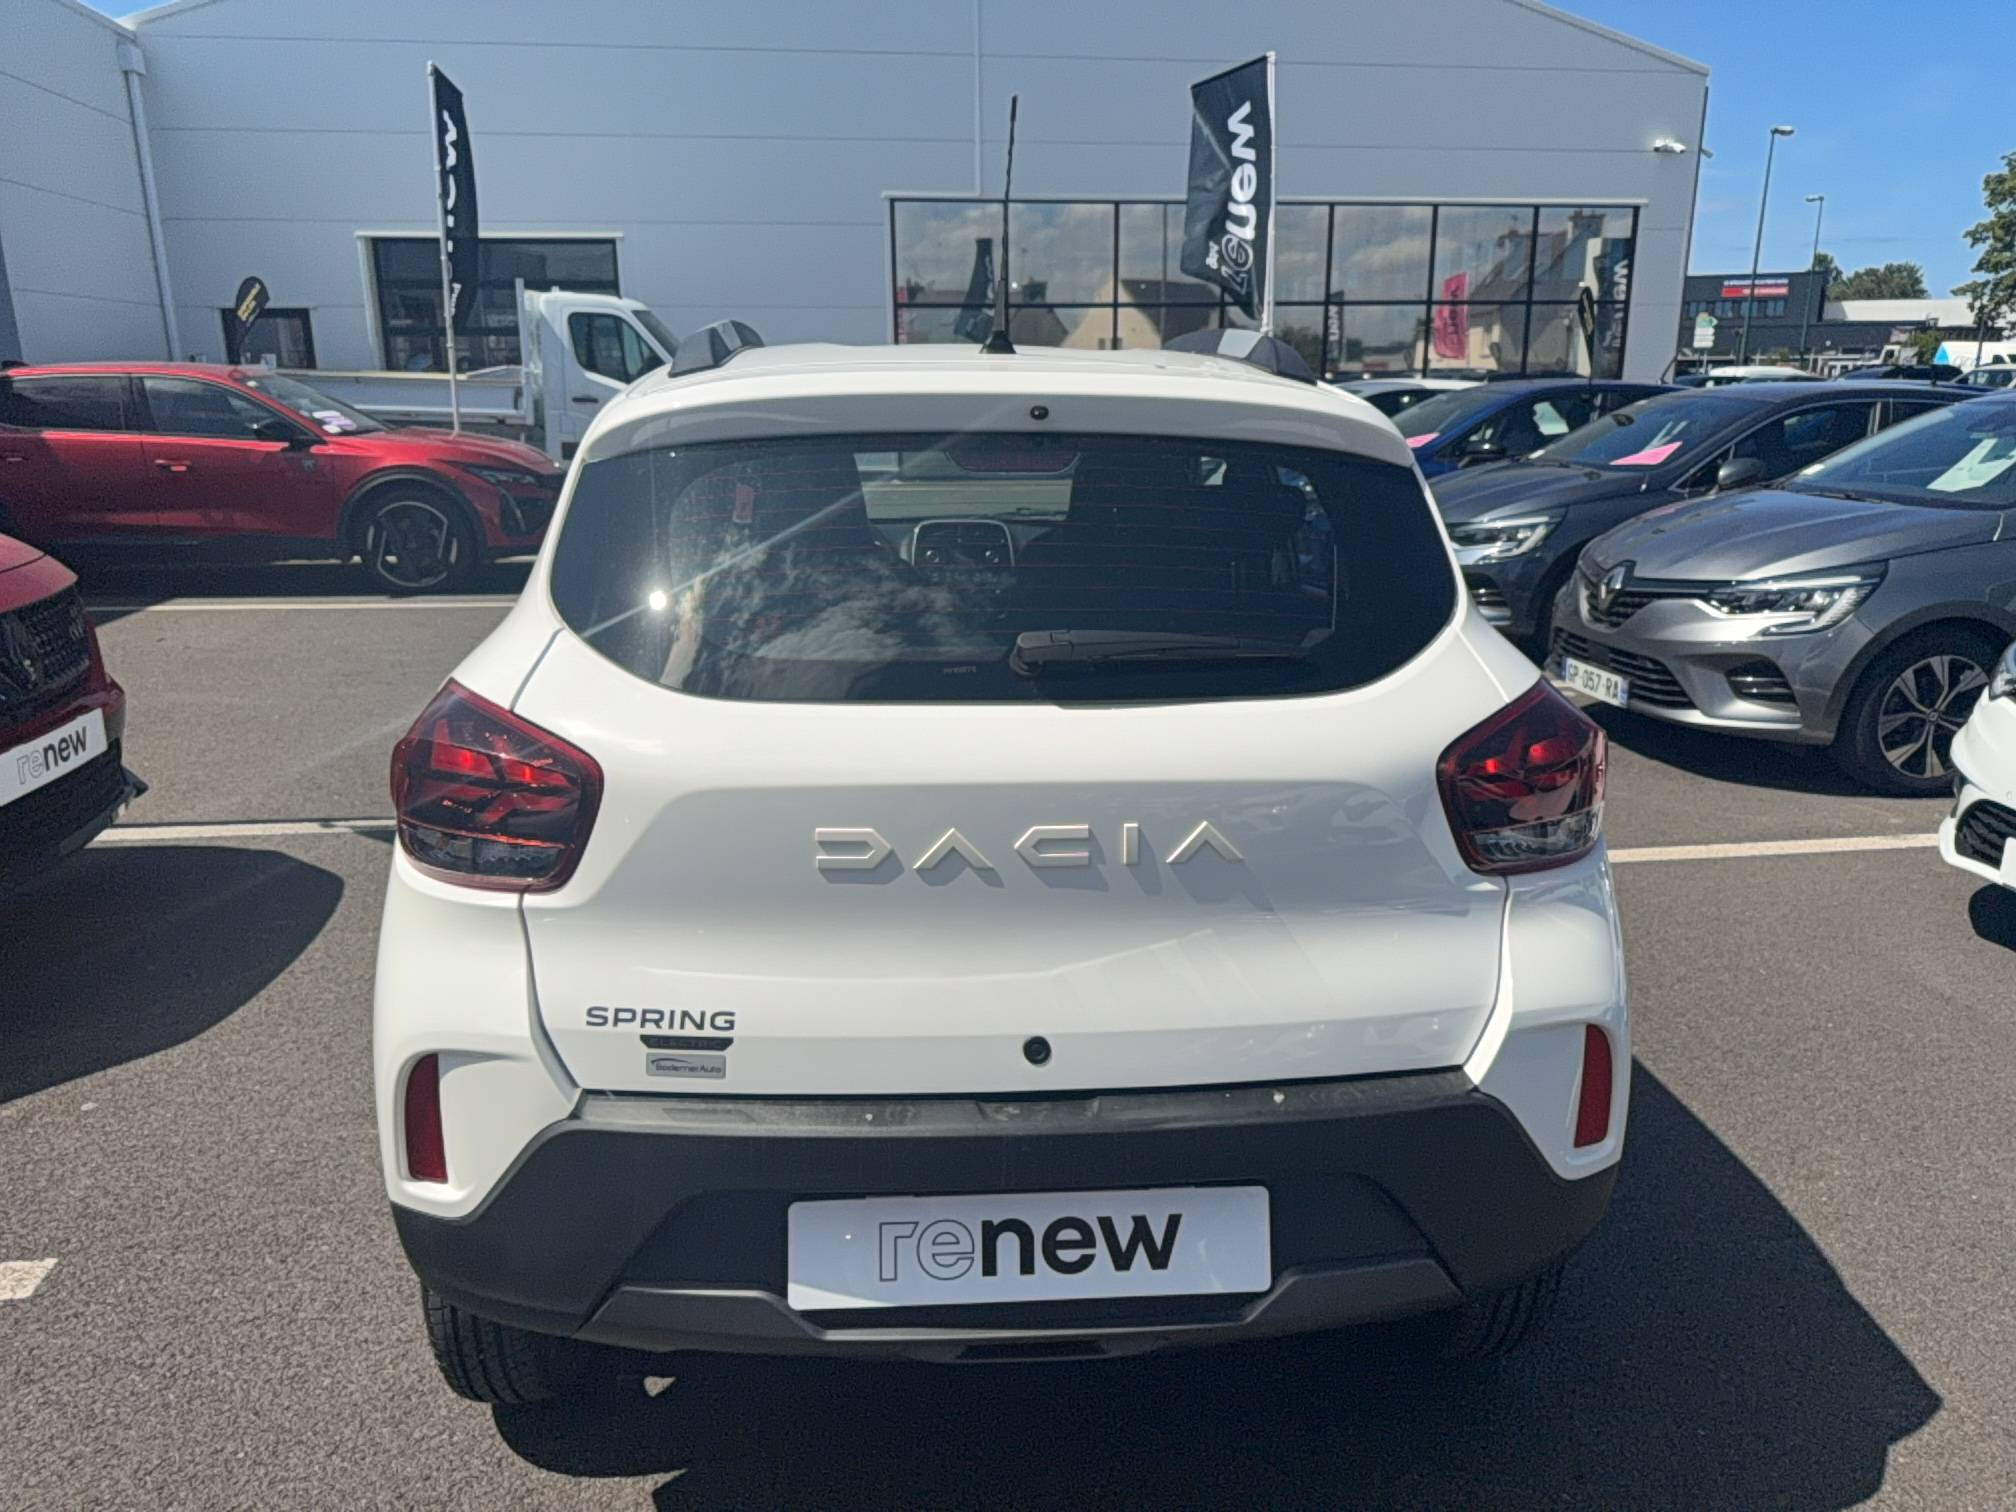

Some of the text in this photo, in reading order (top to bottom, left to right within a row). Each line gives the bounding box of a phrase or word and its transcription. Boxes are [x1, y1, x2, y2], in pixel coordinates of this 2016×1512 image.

[1221, 101, 1257, 294] renew
[17, 726, 87, 785] renew
[815, 820, 1246, 869] DACIA
[586, 1006, 736, 1031] SPRING
[879, 1213, 1183, 1281] renew
